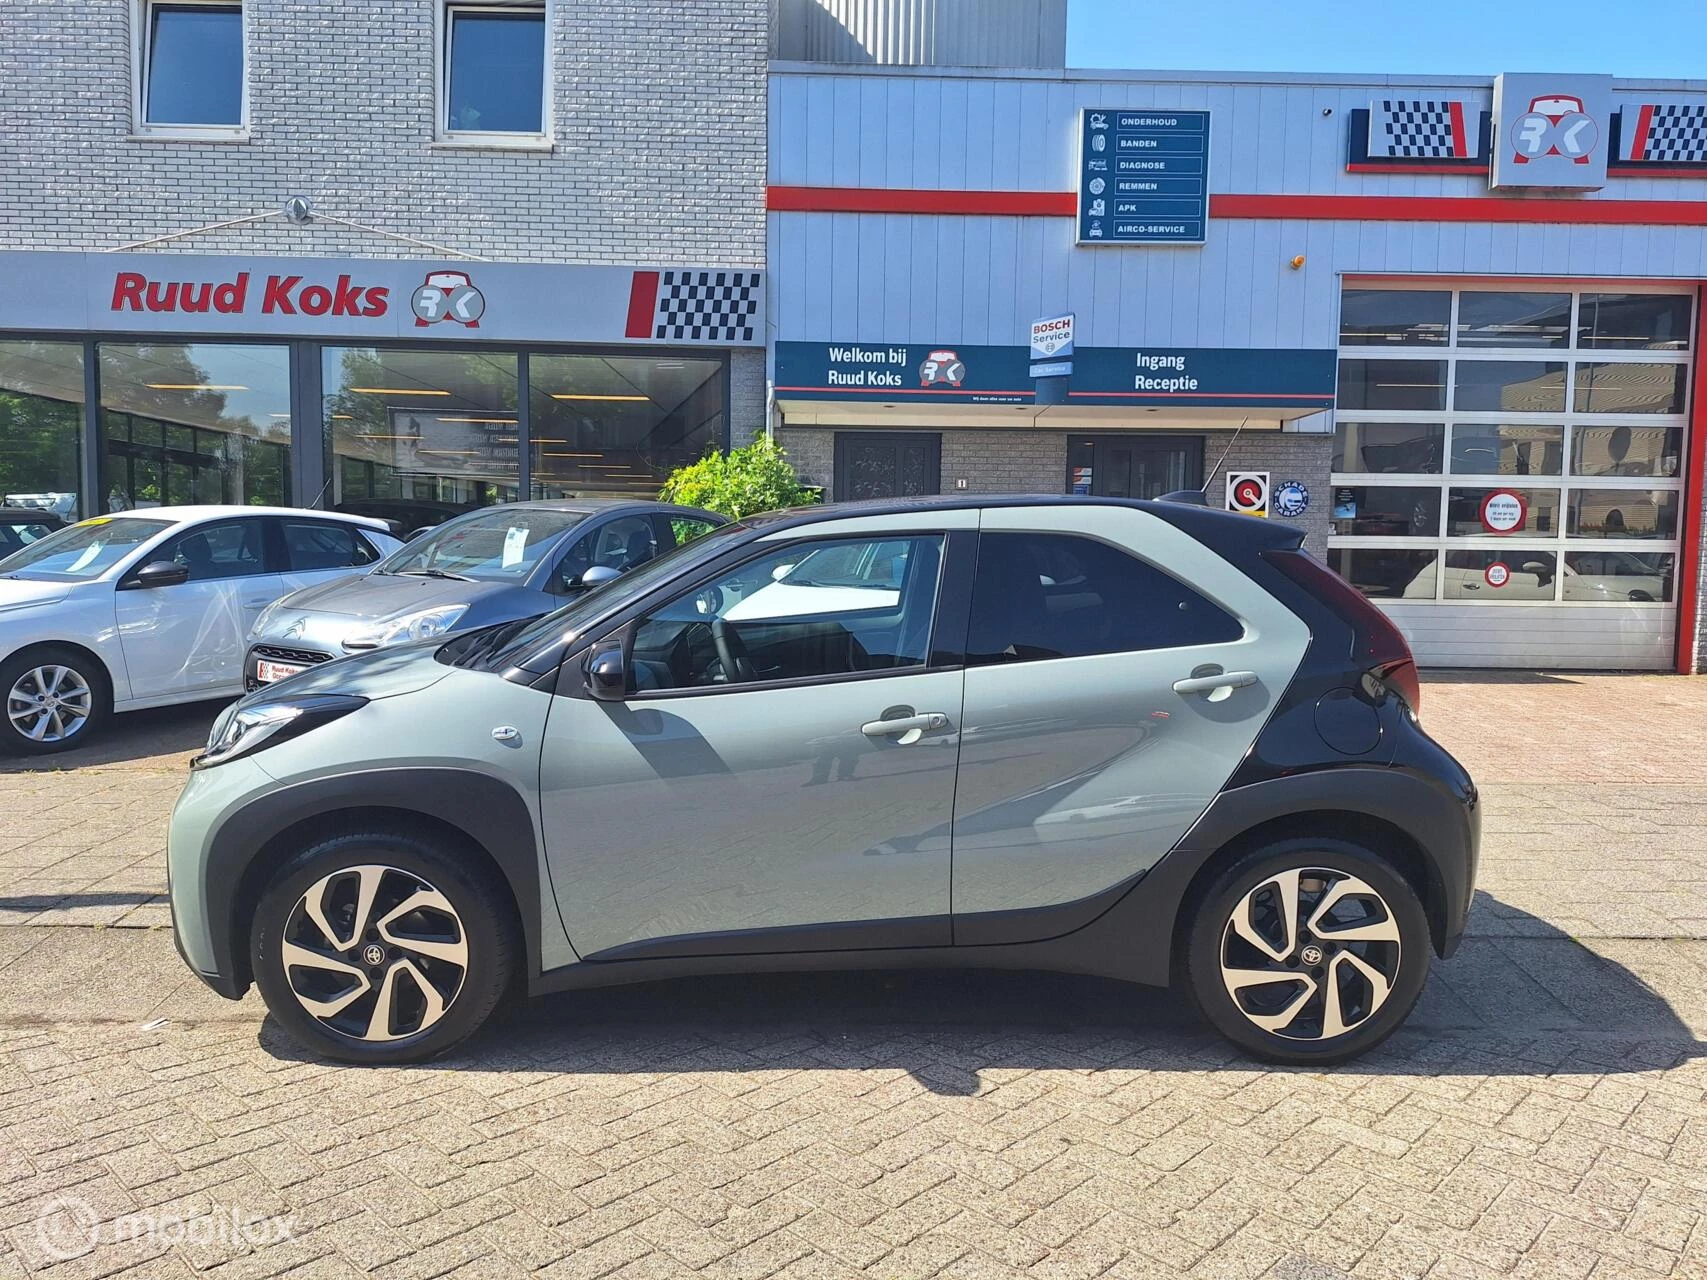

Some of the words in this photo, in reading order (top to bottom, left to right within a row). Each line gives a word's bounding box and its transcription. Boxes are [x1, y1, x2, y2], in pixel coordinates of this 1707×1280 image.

[1121, 118, 1177, 126] ONDERHOUD
[1118, 204, 1137, 212] APK
[111, 272, 250, 313] Ruud
[261, 274, 390, 317] Koks
[1033, 319, 1071, 334] BOSCH
[1032, 331, 1070, 344] Service
[829, 347, 886, 363] Welkom
[888, 348, 907, 367] bij
[1136, 352, 1186, 371] Ingang
[828, 370, 865, 385] Ruud
[867, 371, 902, 386] Koks
[1135, 375, 1198, 393] Receptie
[1274, 481, 1308, 498] SCHADE
[1274, 502, 1306, 517] GARANT
